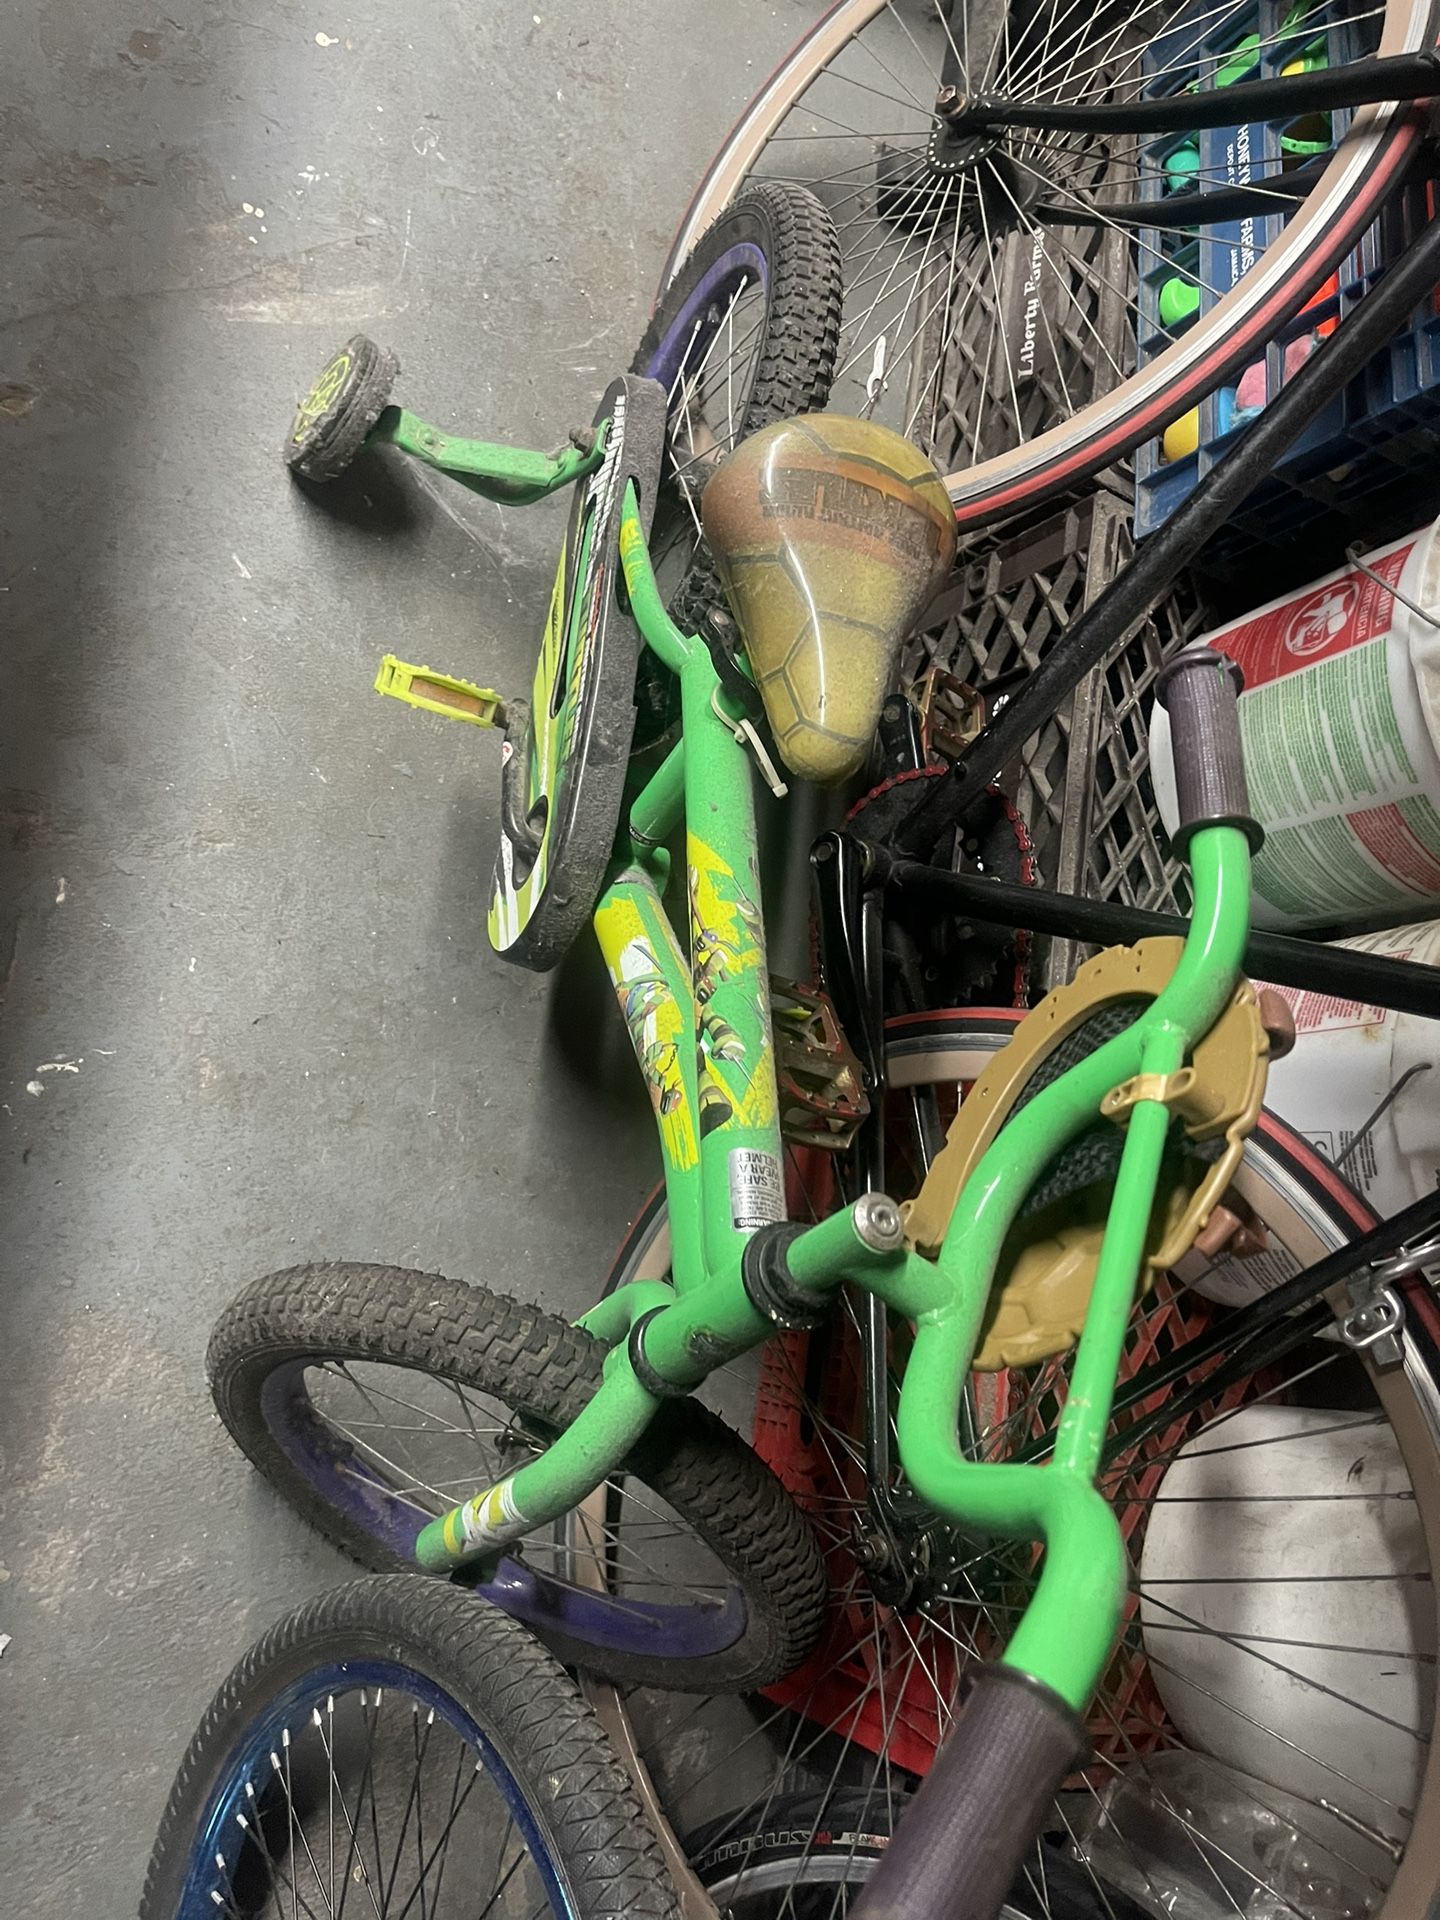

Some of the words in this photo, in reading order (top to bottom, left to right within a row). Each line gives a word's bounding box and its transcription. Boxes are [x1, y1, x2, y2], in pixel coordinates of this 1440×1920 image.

[1237, 124, 1251, 186] HONEYW
[1017, 298, 1040, 379] Liberty
[1356, 567, 1382, 640] AVERTENCIA
[736, 1152, 778, 1170] HELMET
[750, 1163, 780, 1181] WEAR
